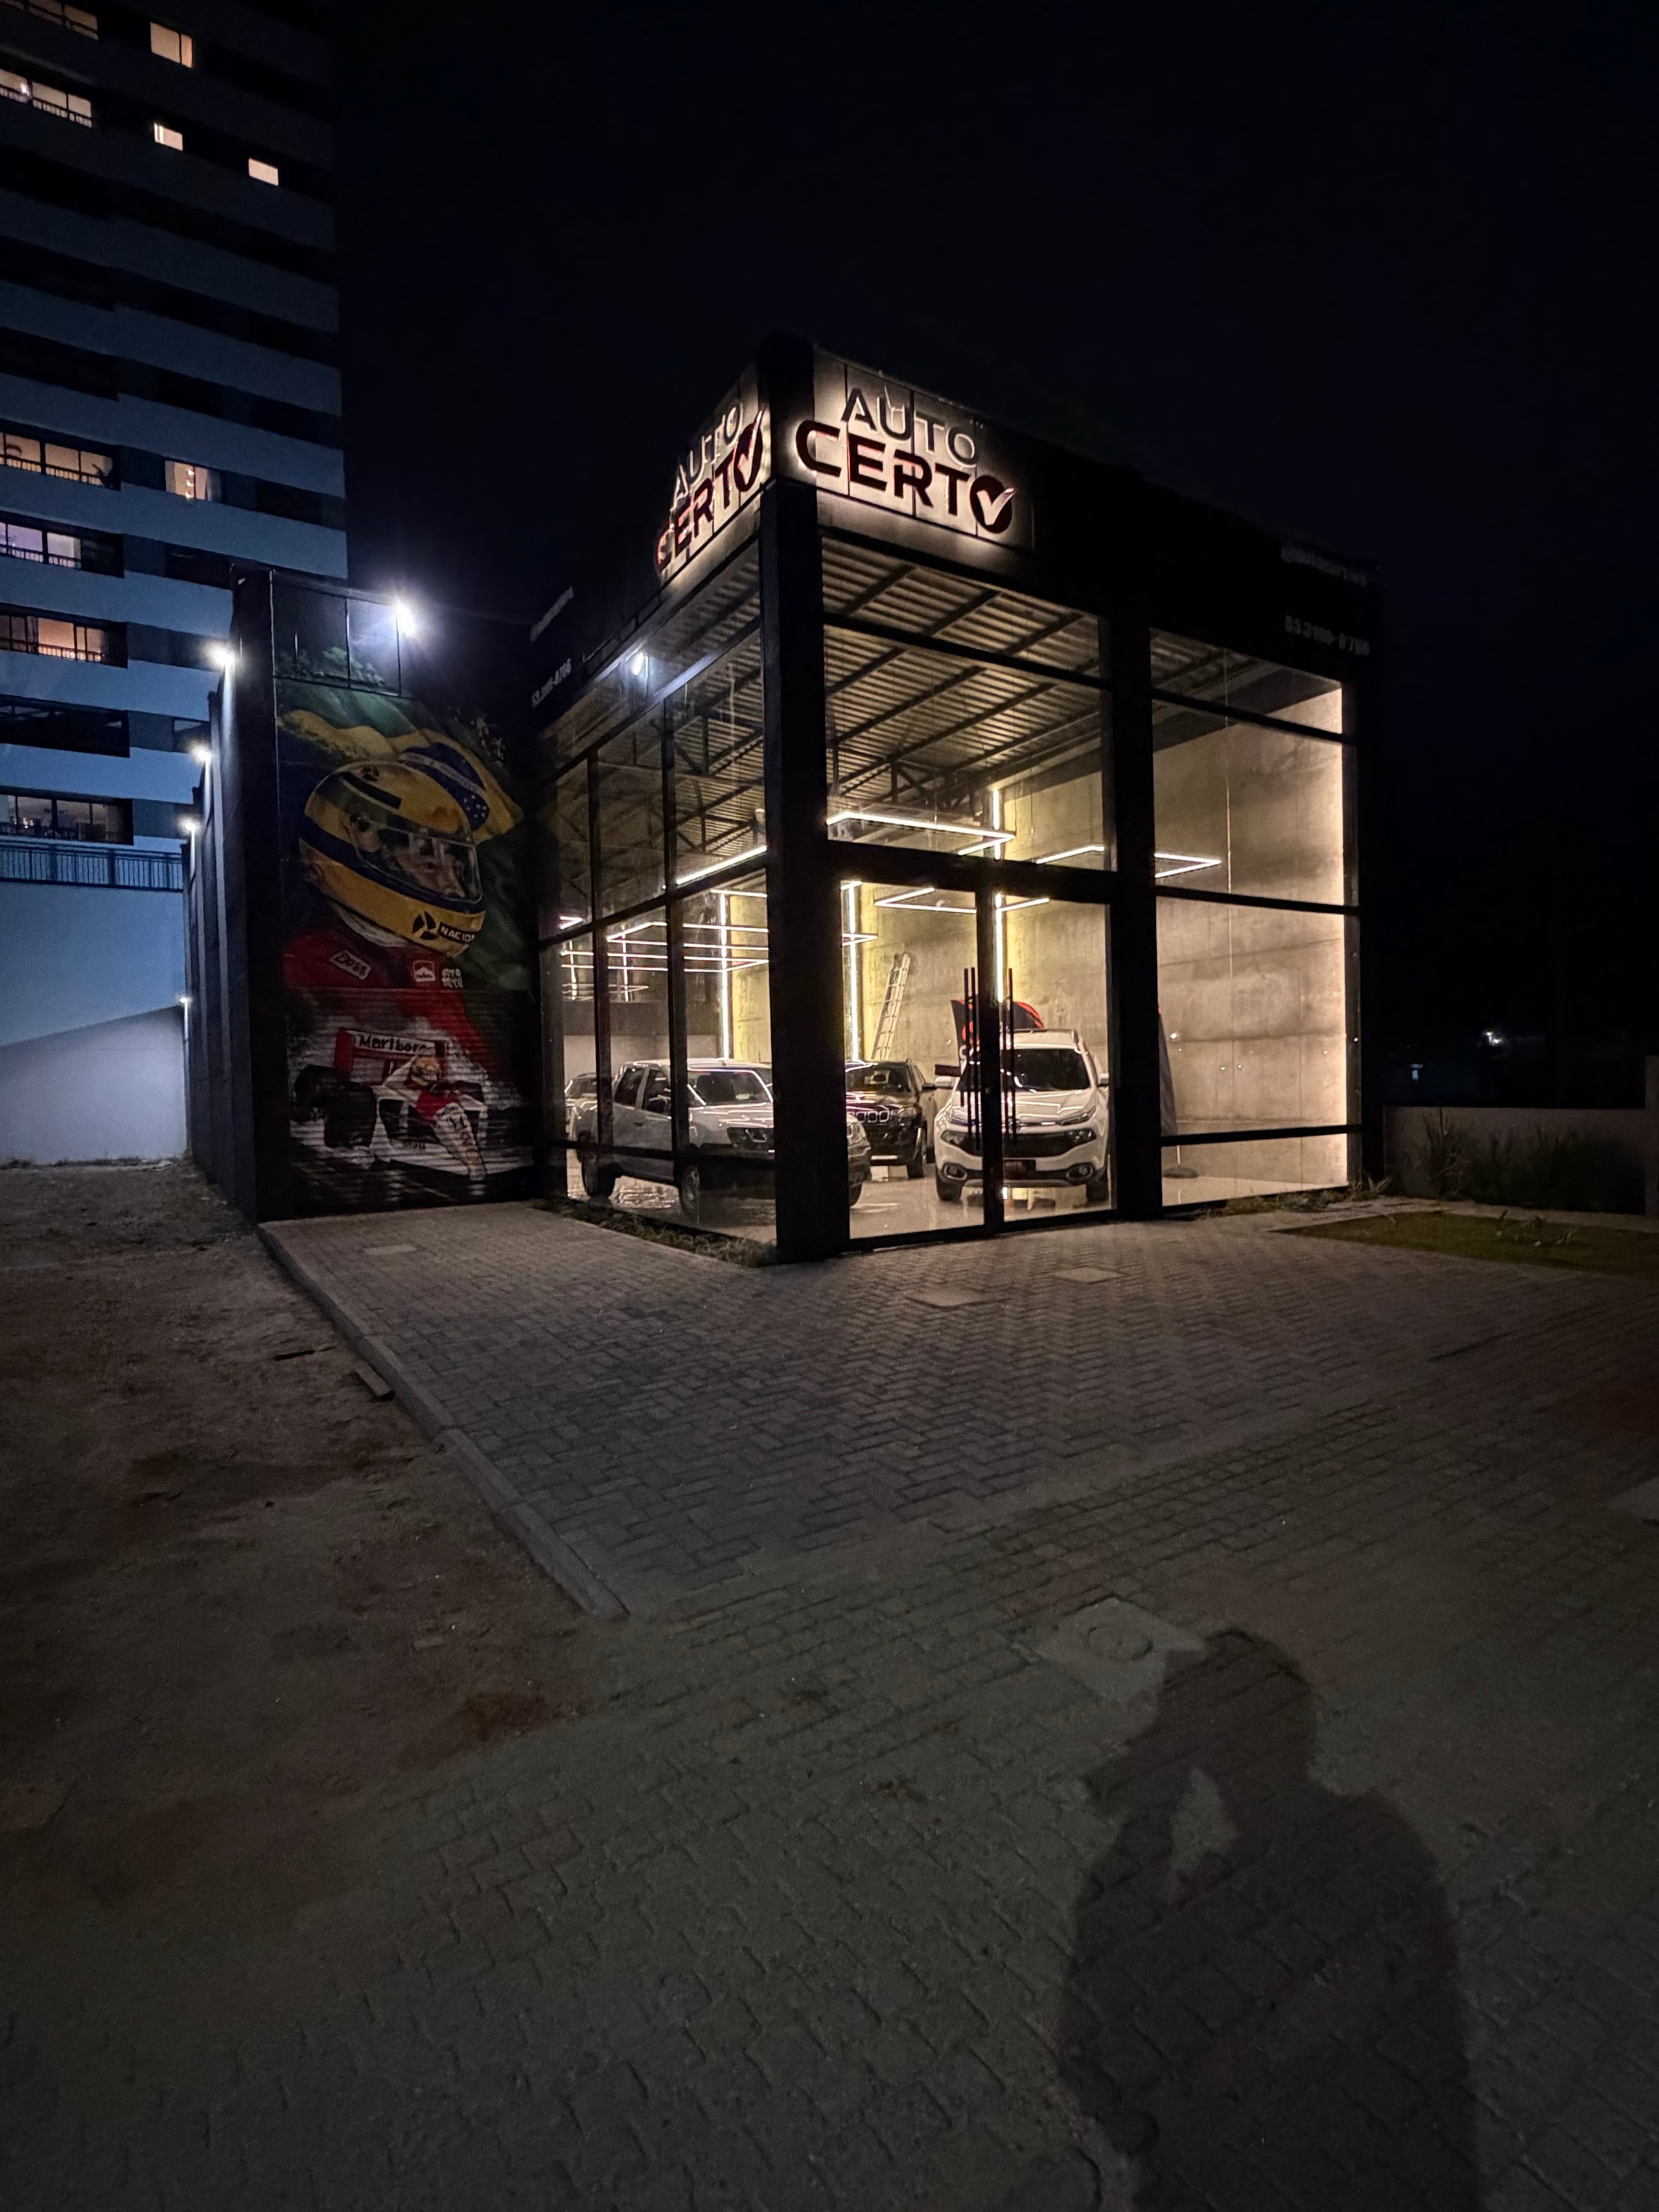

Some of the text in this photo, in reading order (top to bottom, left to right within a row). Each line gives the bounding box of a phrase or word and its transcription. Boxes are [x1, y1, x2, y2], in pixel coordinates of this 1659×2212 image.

[669, 401, 743, 513] AUTO
[795, 419, 1014, 534] CERTO
[842, 388, 979, 468] AUTO
[655, 415, 763, 573] CERTO
